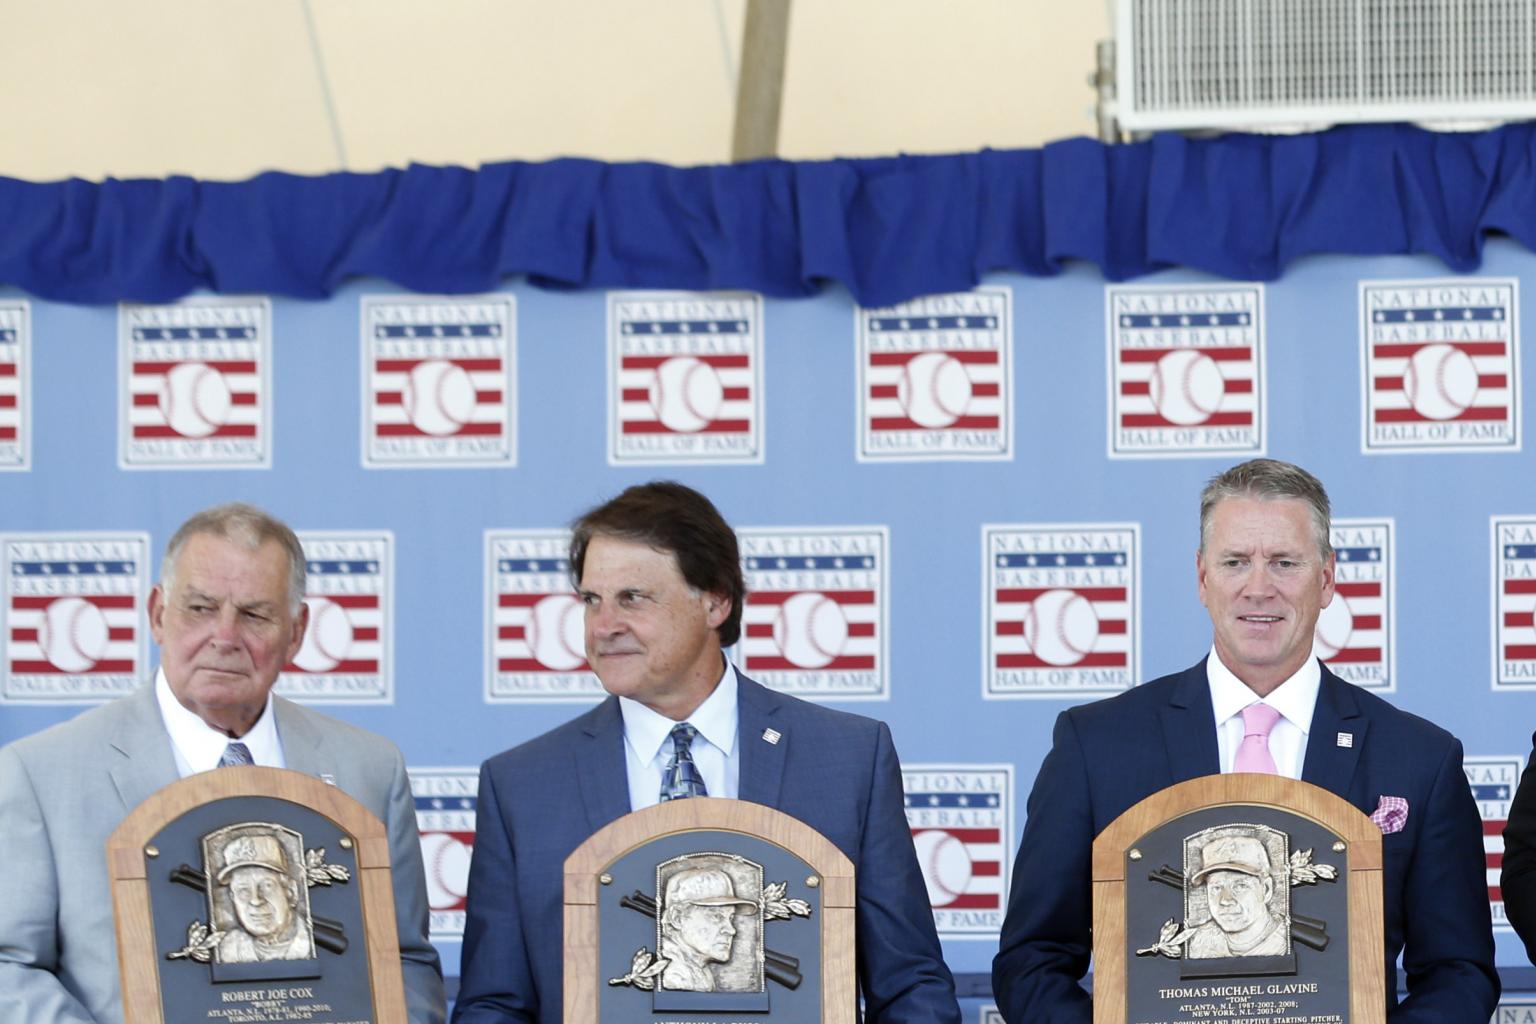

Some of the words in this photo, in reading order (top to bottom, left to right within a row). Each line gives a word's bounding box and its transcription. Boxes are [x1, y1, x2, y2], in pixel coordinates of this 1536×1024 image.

[1120, 294, 1252, 311] NATIONAL
[1373, 289, 1506, 307] NATIONAL
[622, 302, 750, 319] NATIONAL
[1121, 328, 1251, 346] BASEBALL
[1374, 324, 1505, 341] BASEBALL
[622, 336, 750, 353] BASEBALL
[1122, 428, 1170, 445] HALL
[1176, 428, 1198, 444] OF
[1206, 427, 1254, 444] FAME
[1375, 424, 1423, 441] HALL
[1429, 424, 1452, 439] OF
[1459, 422, 1508, 439] FAME
[622, 435, 669, 451] HALL
[674, 435, 696, 450] OF
[703, 434, 751, 450] FAME
[996, 533, 1127, 551] NATIONAL
[996, 568, 1126, 586] BASEBALL
[996, 670, 1044, 686] HALL
[1049, 669, 1072, 685] OF
[1079, 668, 1128, 685] FAME
[222, 990, 265, 1002] ROBERT
[267, 989, 288, 1000] JOE
[289, 988, 313, 998] COX
[1159, 988, 1208, 998] THOMAS
[1211, 986, 1264, 996] MICHAEL
[1267, 983, 1318, 994] GLAVINE
